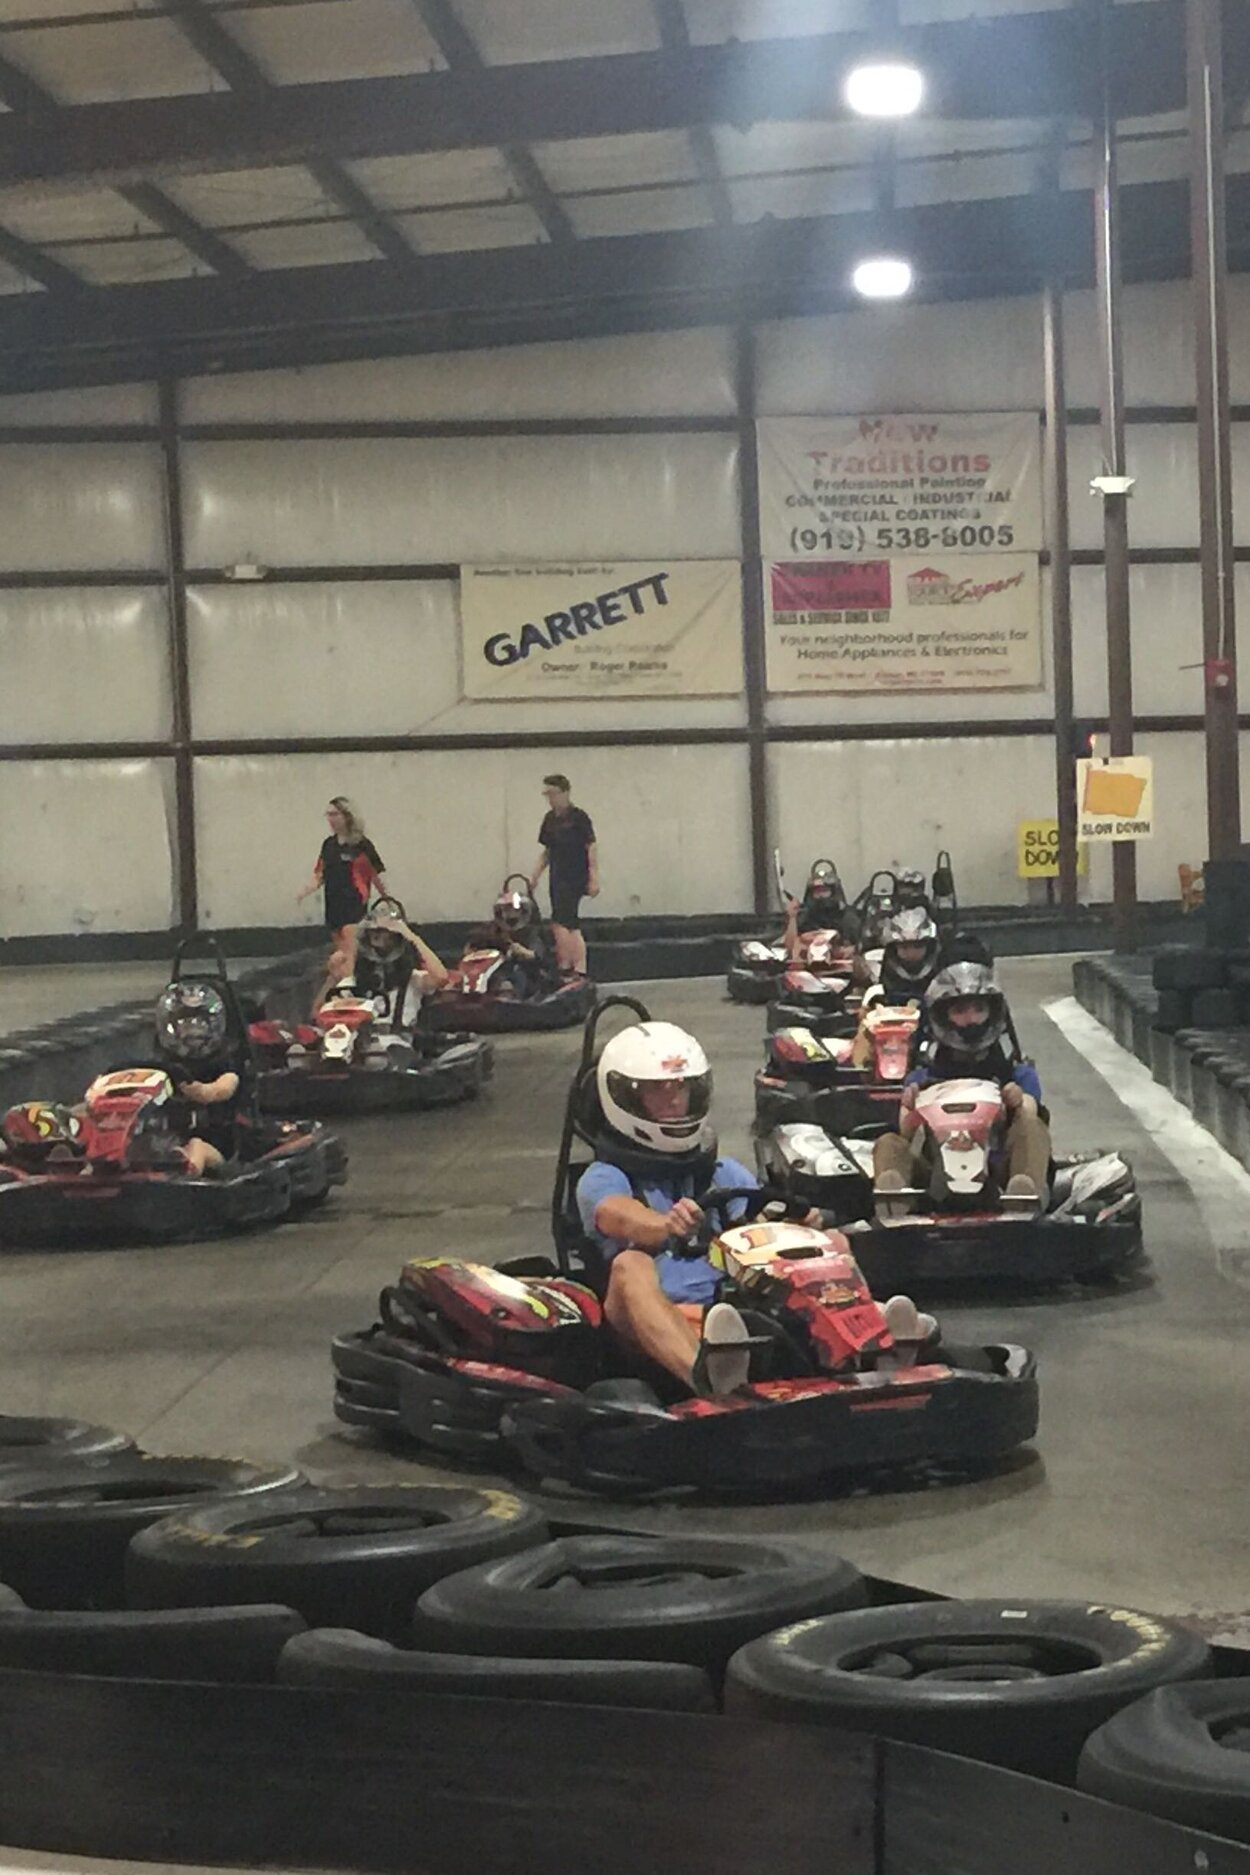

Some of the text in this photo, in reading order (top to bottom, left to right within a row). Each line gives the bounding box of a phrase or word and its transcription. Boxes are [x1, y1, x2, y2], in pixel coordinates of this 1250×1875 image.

[808, 449, 991, 474] Traditions
[813, 478, 914, 490] Professional
[785, 493, 899, 508] COMMERCIAL
[819, 508, 981, 523] SPECIAL COATINGS
[484, 572, 669, 666] GARRETT
[779, 628, 1030, 646] Your neighborhood professionals for
[797, 644, 1009, 661] Home Appliances & Electronics
[1082, 821, 1151, 836] SLOW DOWN
[1025, 830, 1059, 846] SLO
